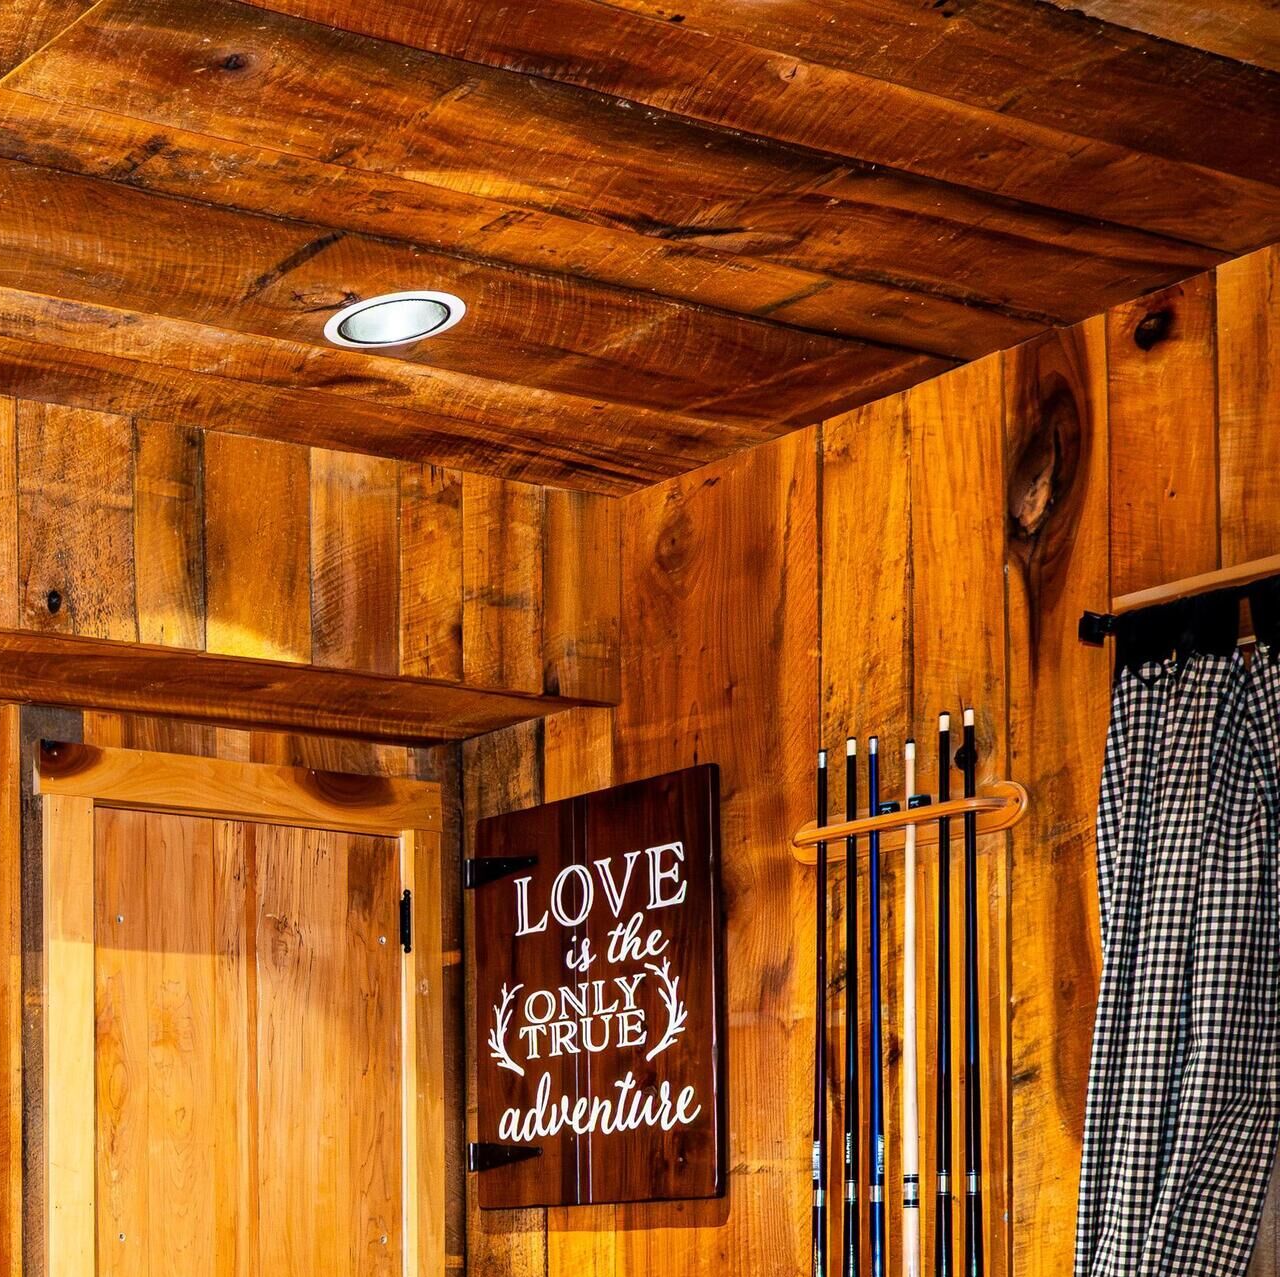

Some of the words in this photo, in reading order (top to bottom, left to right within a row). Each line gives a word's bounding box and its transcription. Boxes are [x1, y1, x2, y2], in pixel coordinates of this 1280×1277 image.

[513, 841, 688, 937] LOVE
[565, 935, 597, 973] is
[606, 911, 670, 964] the
[524, 972, 647, 1025] ONLY
[518, 1008, 648, 1061] TRUE
[498, 1071, 702, 1143] adventure
